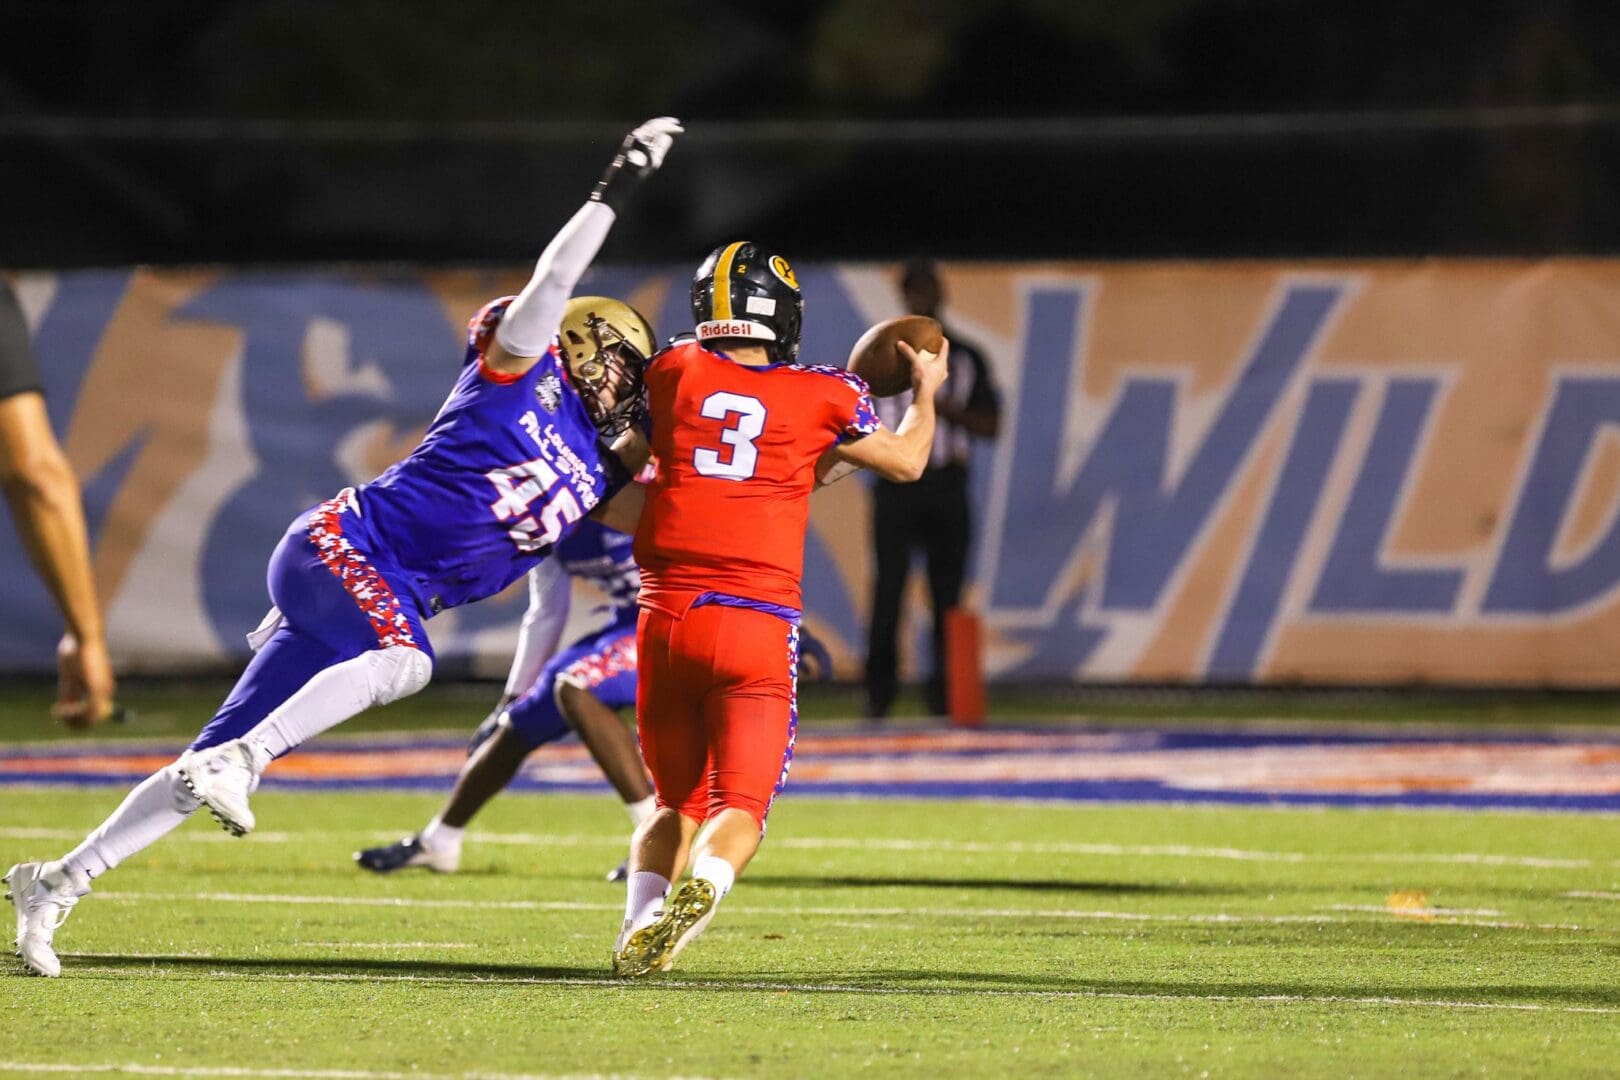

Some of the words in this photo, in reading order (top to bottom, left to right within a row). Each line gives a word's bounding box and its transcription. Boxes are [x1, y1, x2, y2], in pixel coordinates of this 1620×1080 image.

[738, 264, 747, 274] 2
[701, 323, 752, 337] Riddell
[693, 390, 768, 481] 3
[484, 457, 583, 551] 45
